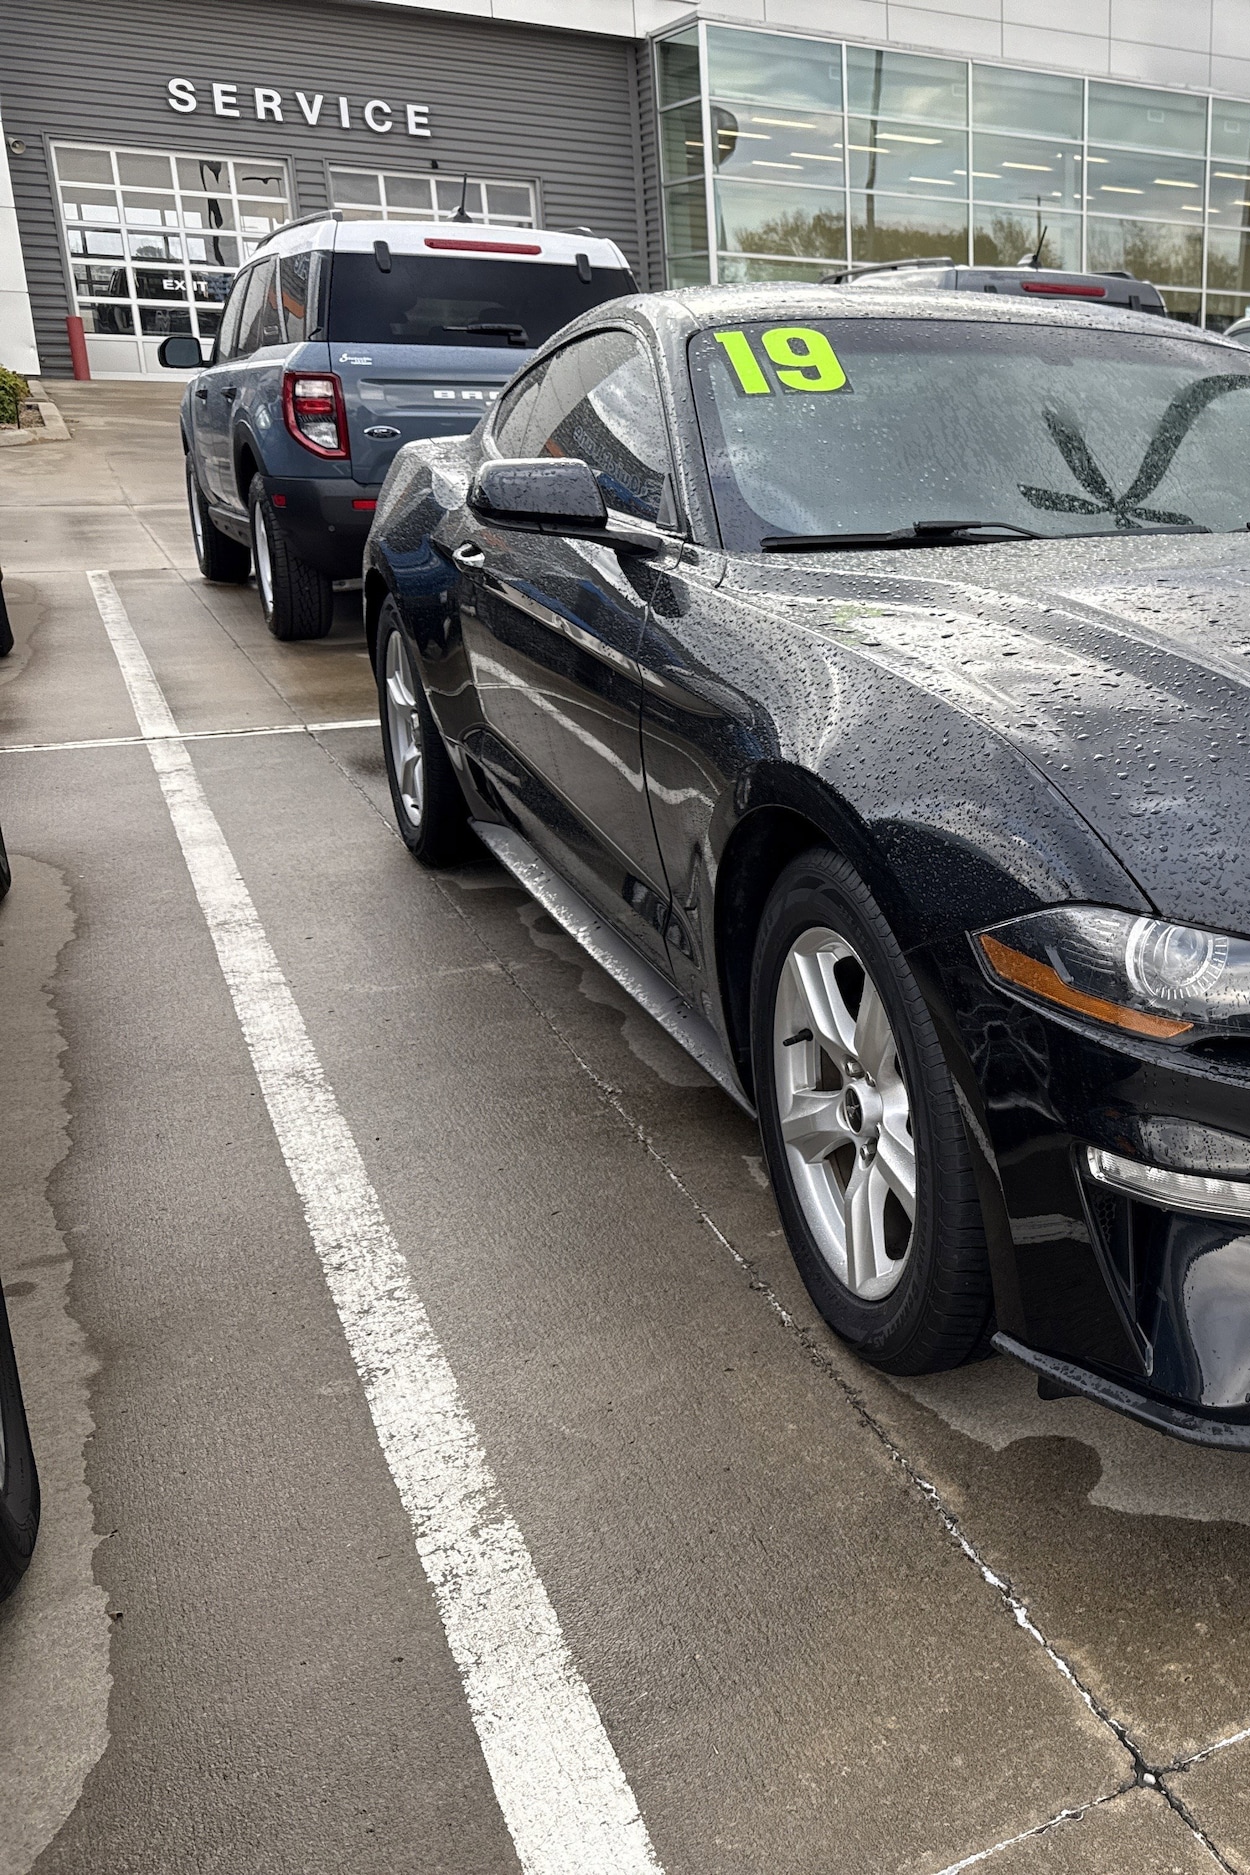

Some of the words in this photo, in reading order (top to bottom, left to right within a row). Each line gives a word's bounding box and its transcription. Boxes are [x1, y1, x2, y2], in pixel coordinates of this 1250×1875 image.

[167, 77, 432, 137] SERVICE
[162, 279, 208, 292] EXIT
[713, 327, 847, 394] 19
